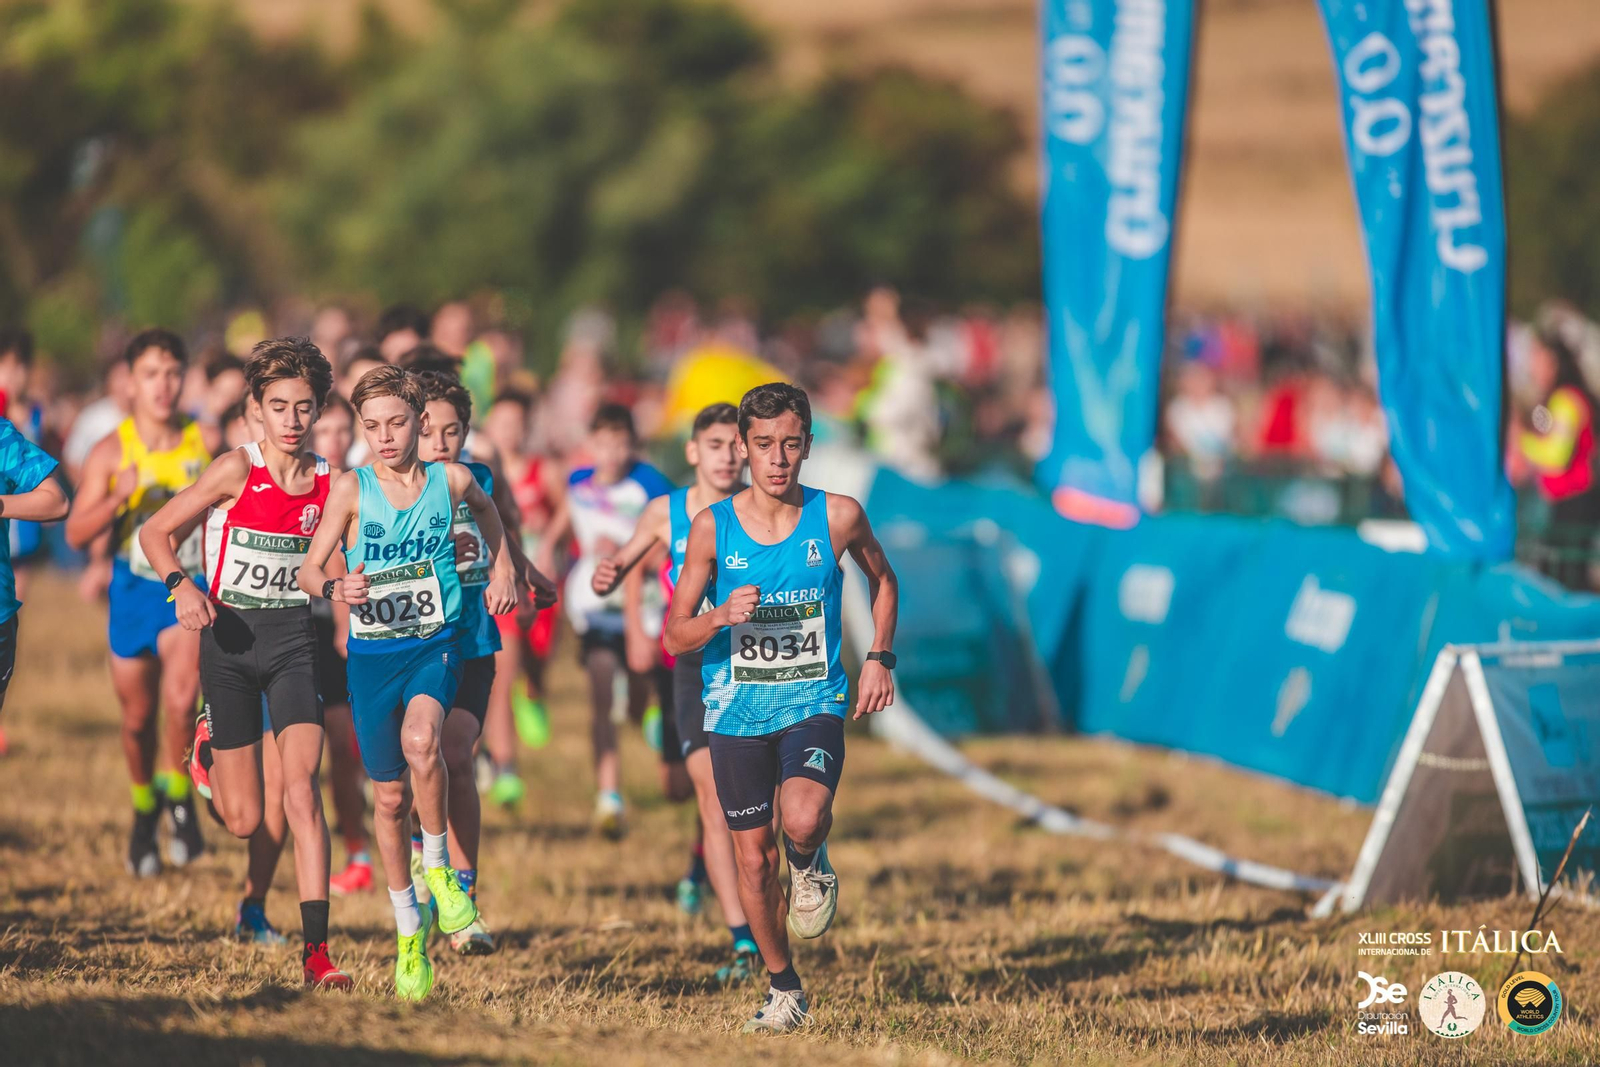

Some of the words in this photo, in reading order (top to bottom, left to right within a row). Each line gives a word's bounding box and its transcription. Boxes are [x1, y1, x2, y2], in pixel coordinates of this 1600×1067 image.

[364, 525, 385, 536] TROPS
[253, 535, 296, 549] ITÁLICA
[363, 529, 441, 563] nerja
[725, 550, 749, 570] als
[232, 559, 301, 592] 7948
[370, 567, 412, 582] TÁLICA
[357, 589, 437, 626] 8028
[756, 606, 801, 619] ITÁLICA
[739, 630, 821, 662] 8034
